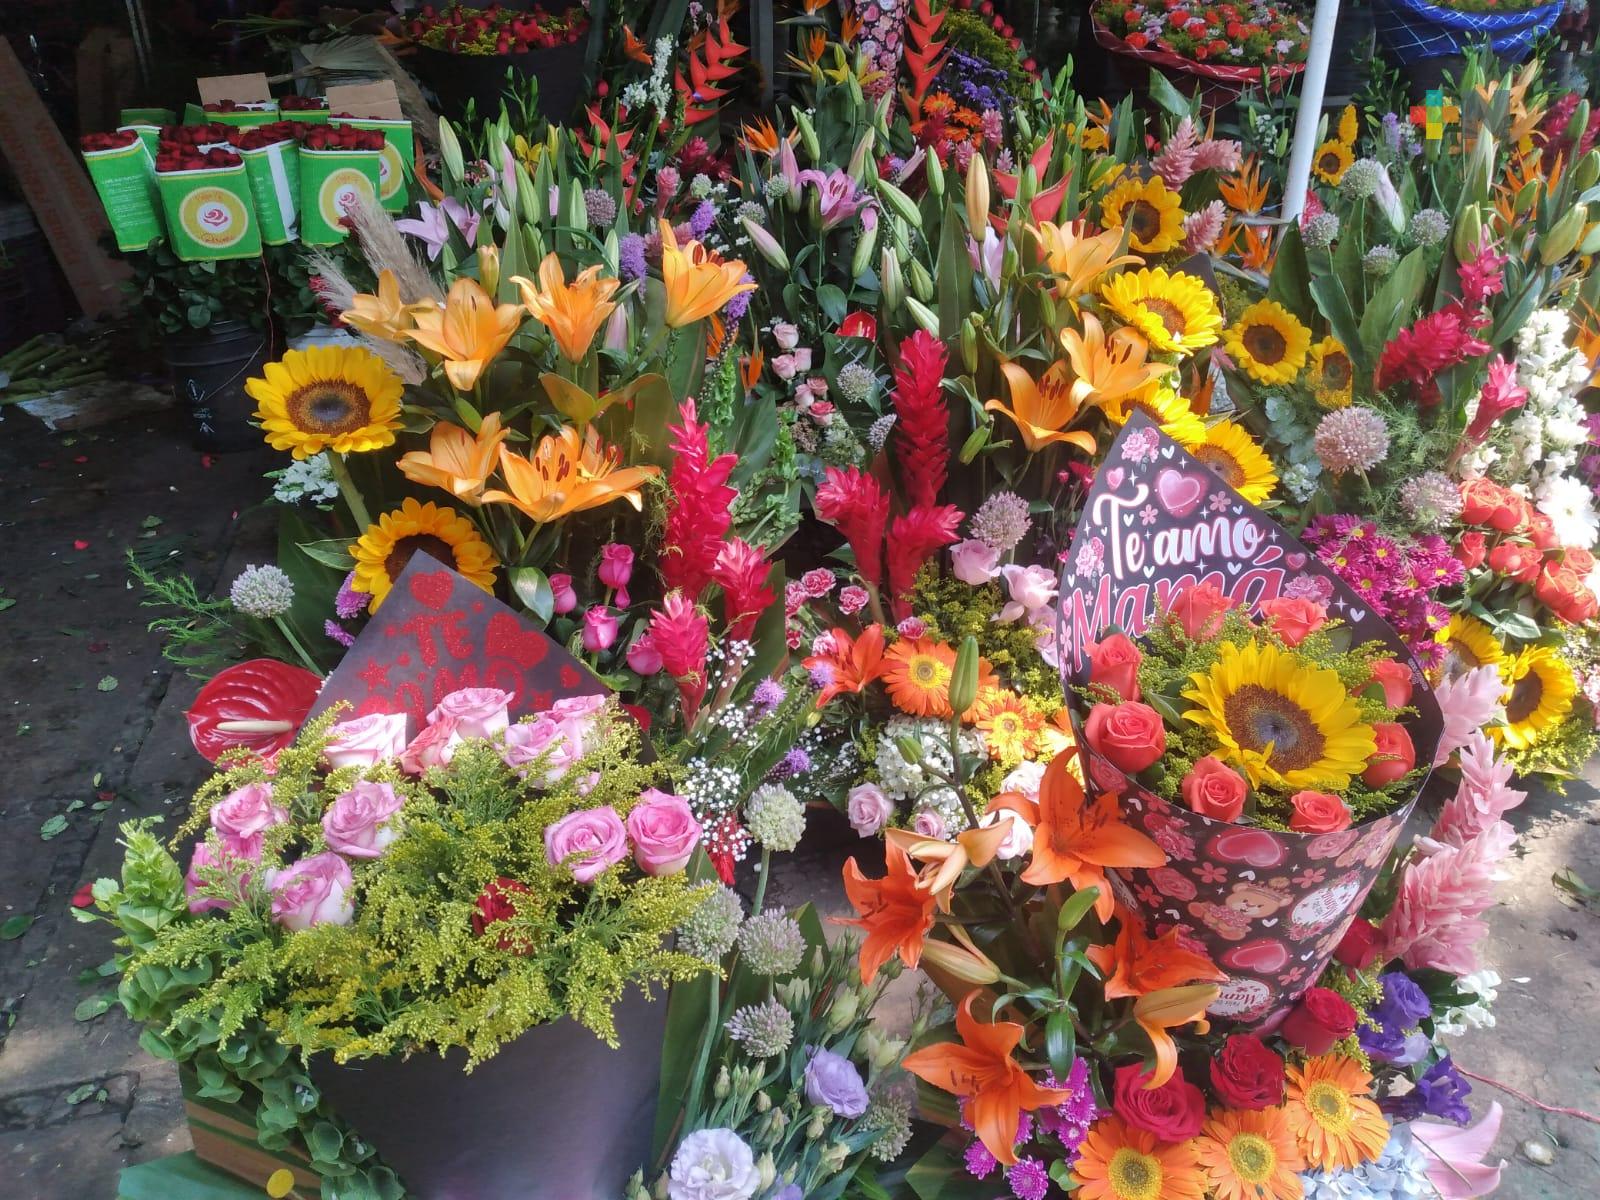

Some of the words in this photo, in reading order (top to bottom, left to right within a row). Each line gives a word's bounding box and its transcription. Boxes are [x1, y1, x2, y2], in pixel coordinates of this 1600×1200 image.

[1092, 483, 1149, 580] Te
[1153, 517, 1265, 566] amo
[402, 610, 473, 668] TE
